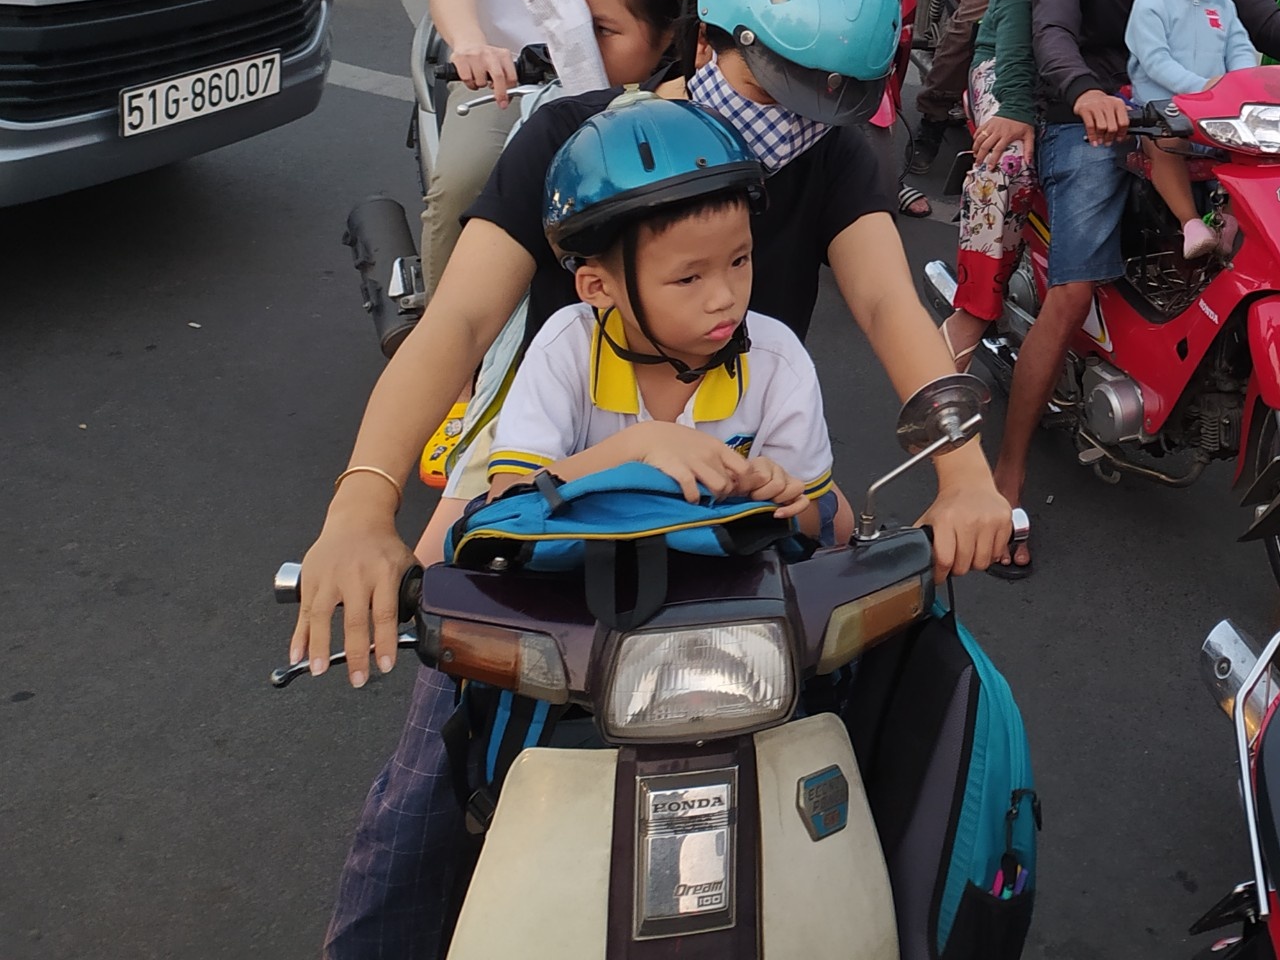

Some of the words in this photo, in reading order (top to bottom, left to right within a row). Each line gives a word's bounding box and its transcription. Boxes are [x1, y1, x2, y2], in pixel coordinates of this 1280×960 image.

[127, 56, 276, 131] 51G-860.07
[652, 796, 725, 814] HONDA
[673, 879, 724, 898] Dream
[698, 894, 723, 907] 100
